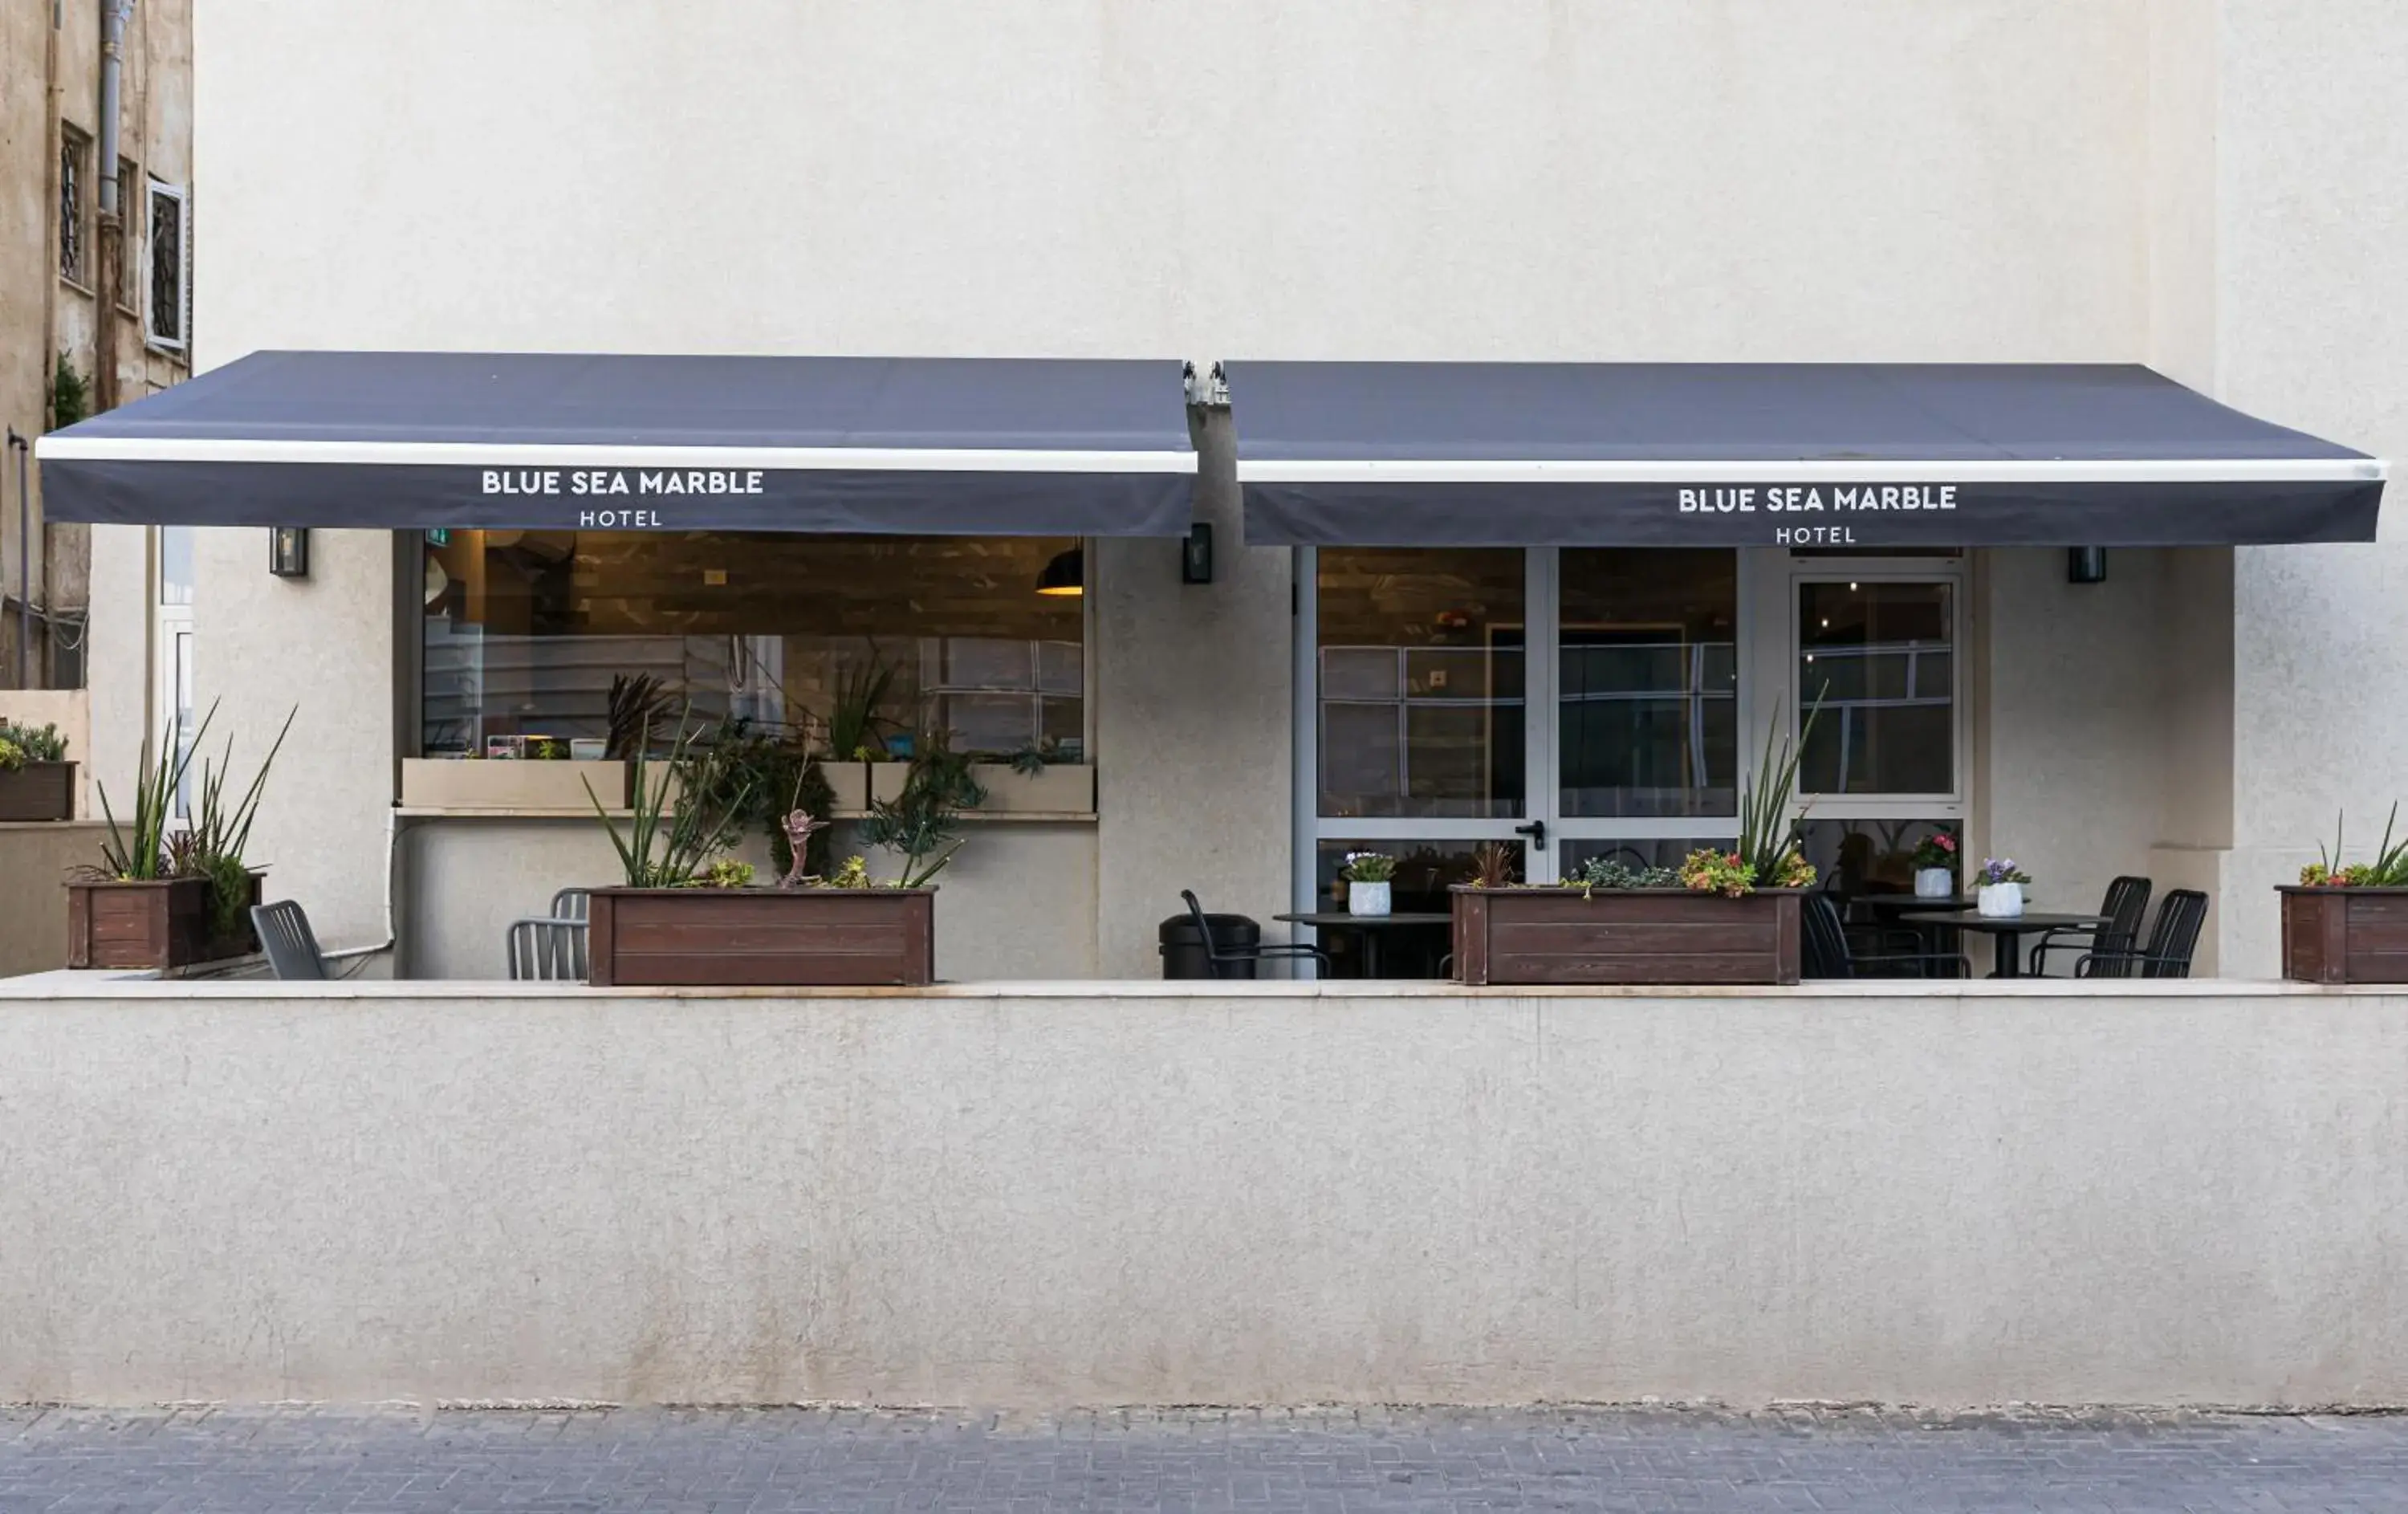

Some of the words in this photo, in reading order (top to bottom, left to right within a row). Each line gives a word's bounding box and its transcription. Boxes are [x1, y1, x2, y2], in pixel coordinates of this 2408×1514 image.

[482, 470, 560, 494] BLUE
[571, 471, 630, 494] SEA
[640, 470, 763, 494] MARBLE
[1679, 488, 1755, 512] BLUE
[1767, 487, 1824, 511] SEA
[1834, 486, 1957, 511] MARBLE
[580, 510, 661, 527] HOTEL
[1776, 527, 1856, 543] HOTEL
